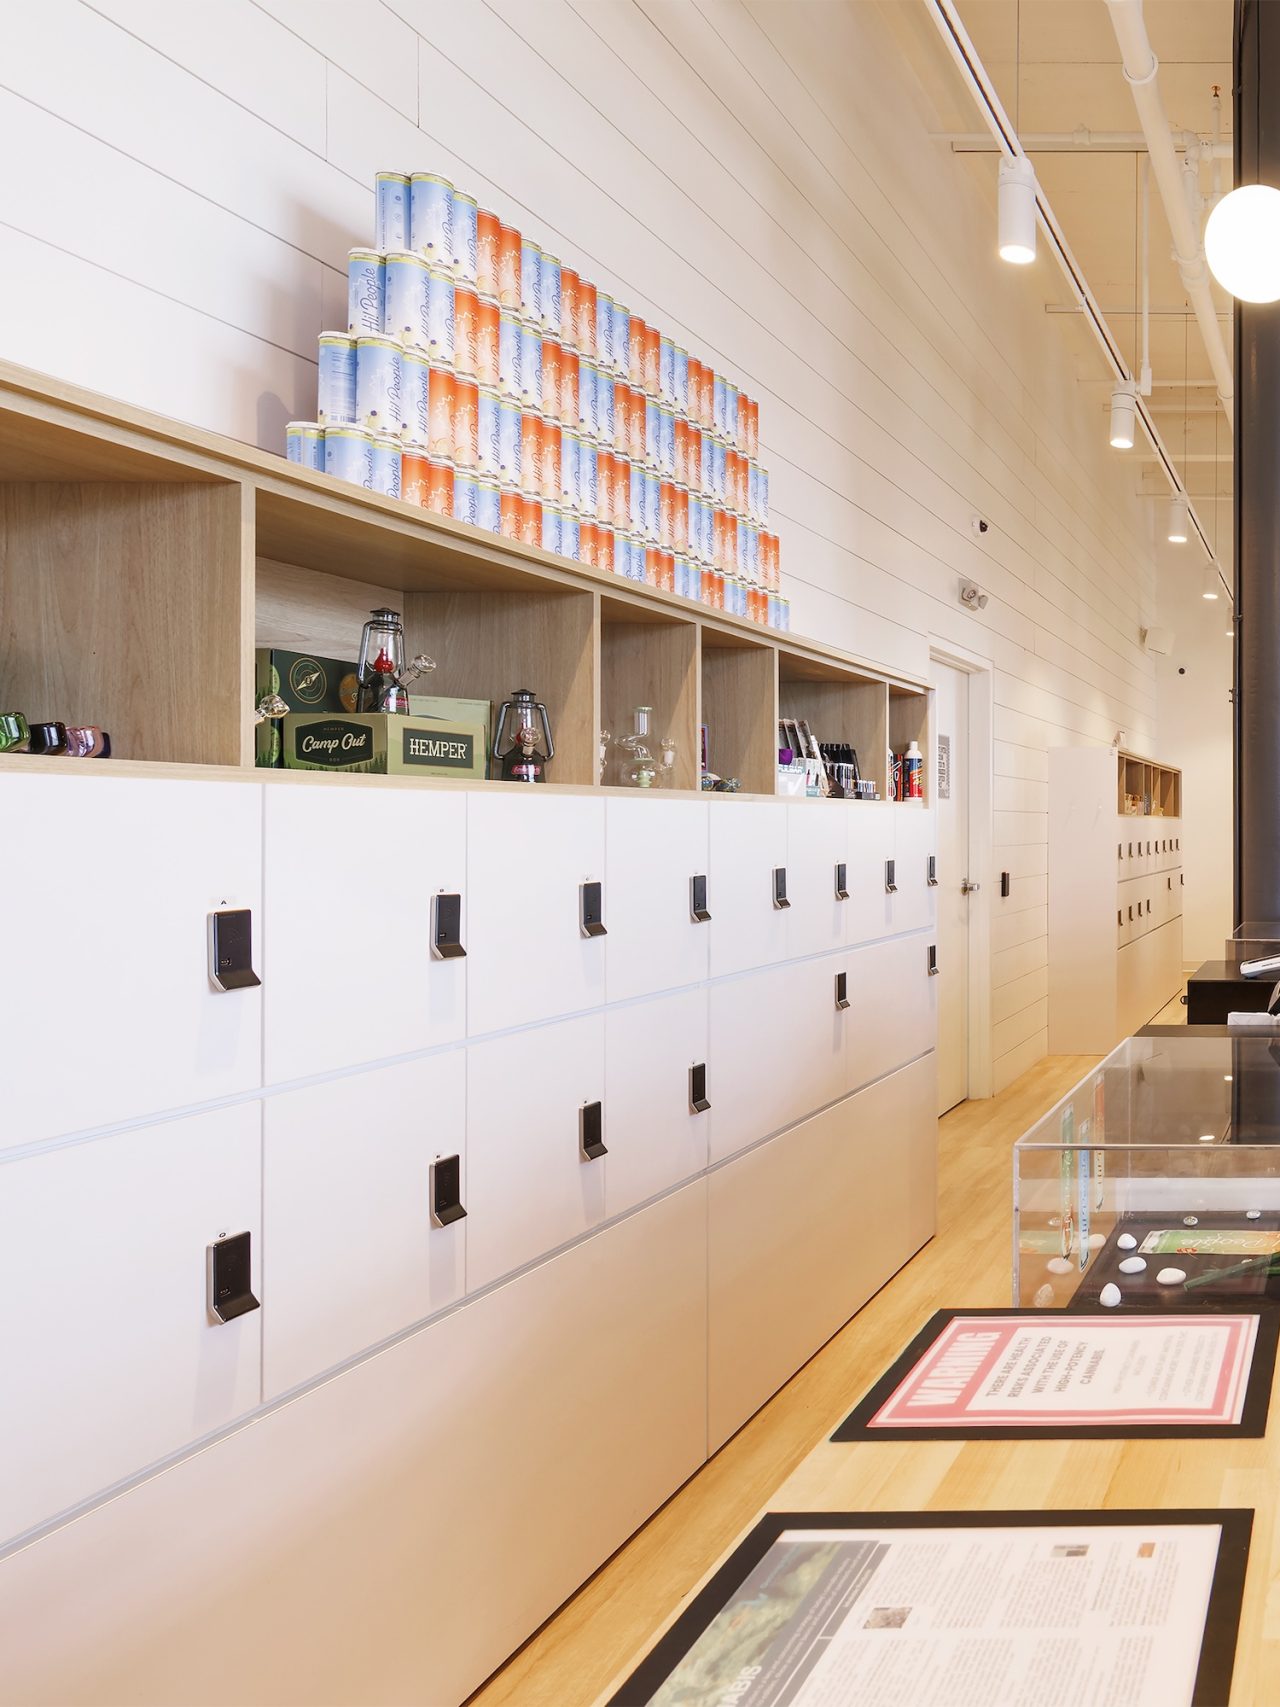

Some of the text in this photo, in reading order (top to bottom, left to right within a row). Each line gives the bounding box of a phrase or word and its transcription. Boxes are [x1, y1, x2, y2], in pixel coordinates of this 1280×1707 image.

[360, 267, 384, 332] Hi! People
[387, 356, 403, 423] Hi! People
[302, 733, 367, 753] Camp Out
[409, 738, 466, 760] HEMPER
[906, 1332, 1002, 1406] WARNING
[985, 1375, 1009, 1397] THERE
[1008, 1337, 1032, 1361] HEALTH
[1007, 1336, 1052, 1397] RISKS ASSOCIATED
[1031, 1375, 1052, 1394] WITH
[1054, 1342, 1088, 1392] HIGH-POTENCY
